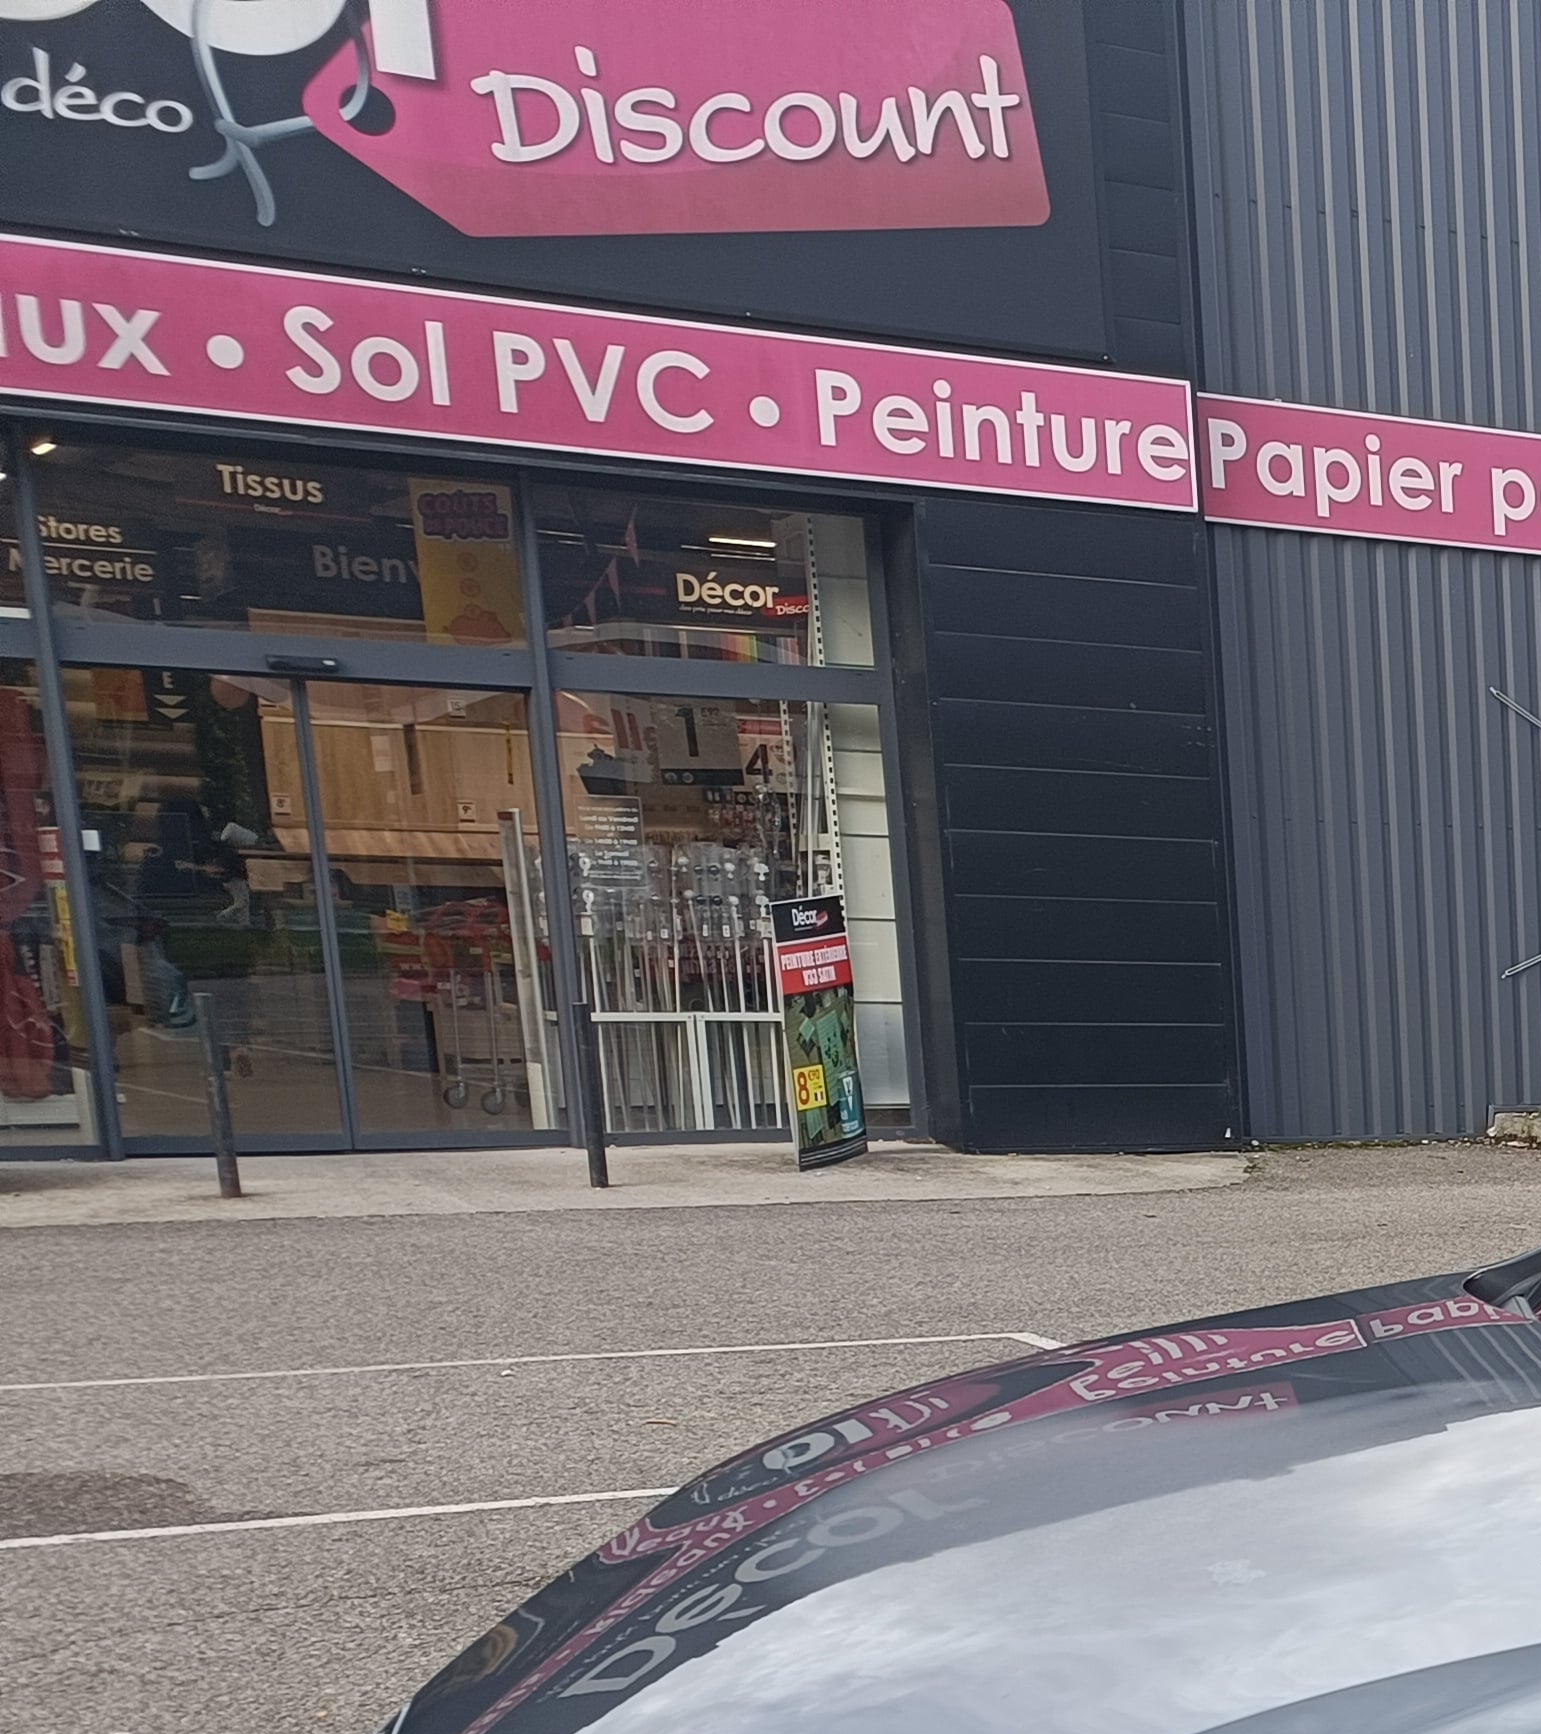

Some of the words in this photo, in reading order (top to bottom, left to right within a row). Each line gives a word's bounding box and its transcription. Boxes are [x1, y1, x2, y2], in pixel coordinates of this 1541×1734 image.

[2, 47, 193, 133] déco
[471, 46, 1020, 163] Discount
[0, 295, 170, 376] ux
[283, 305, 450, 407] Sol
[492, 330, 714, 433] PVC
[814, 368, 1188, 482] Peinture
[216, 464, 323, 503] Tissus
[1207, 418, 1463, 517] Papier
[676, 572, 779, 608] Décor
